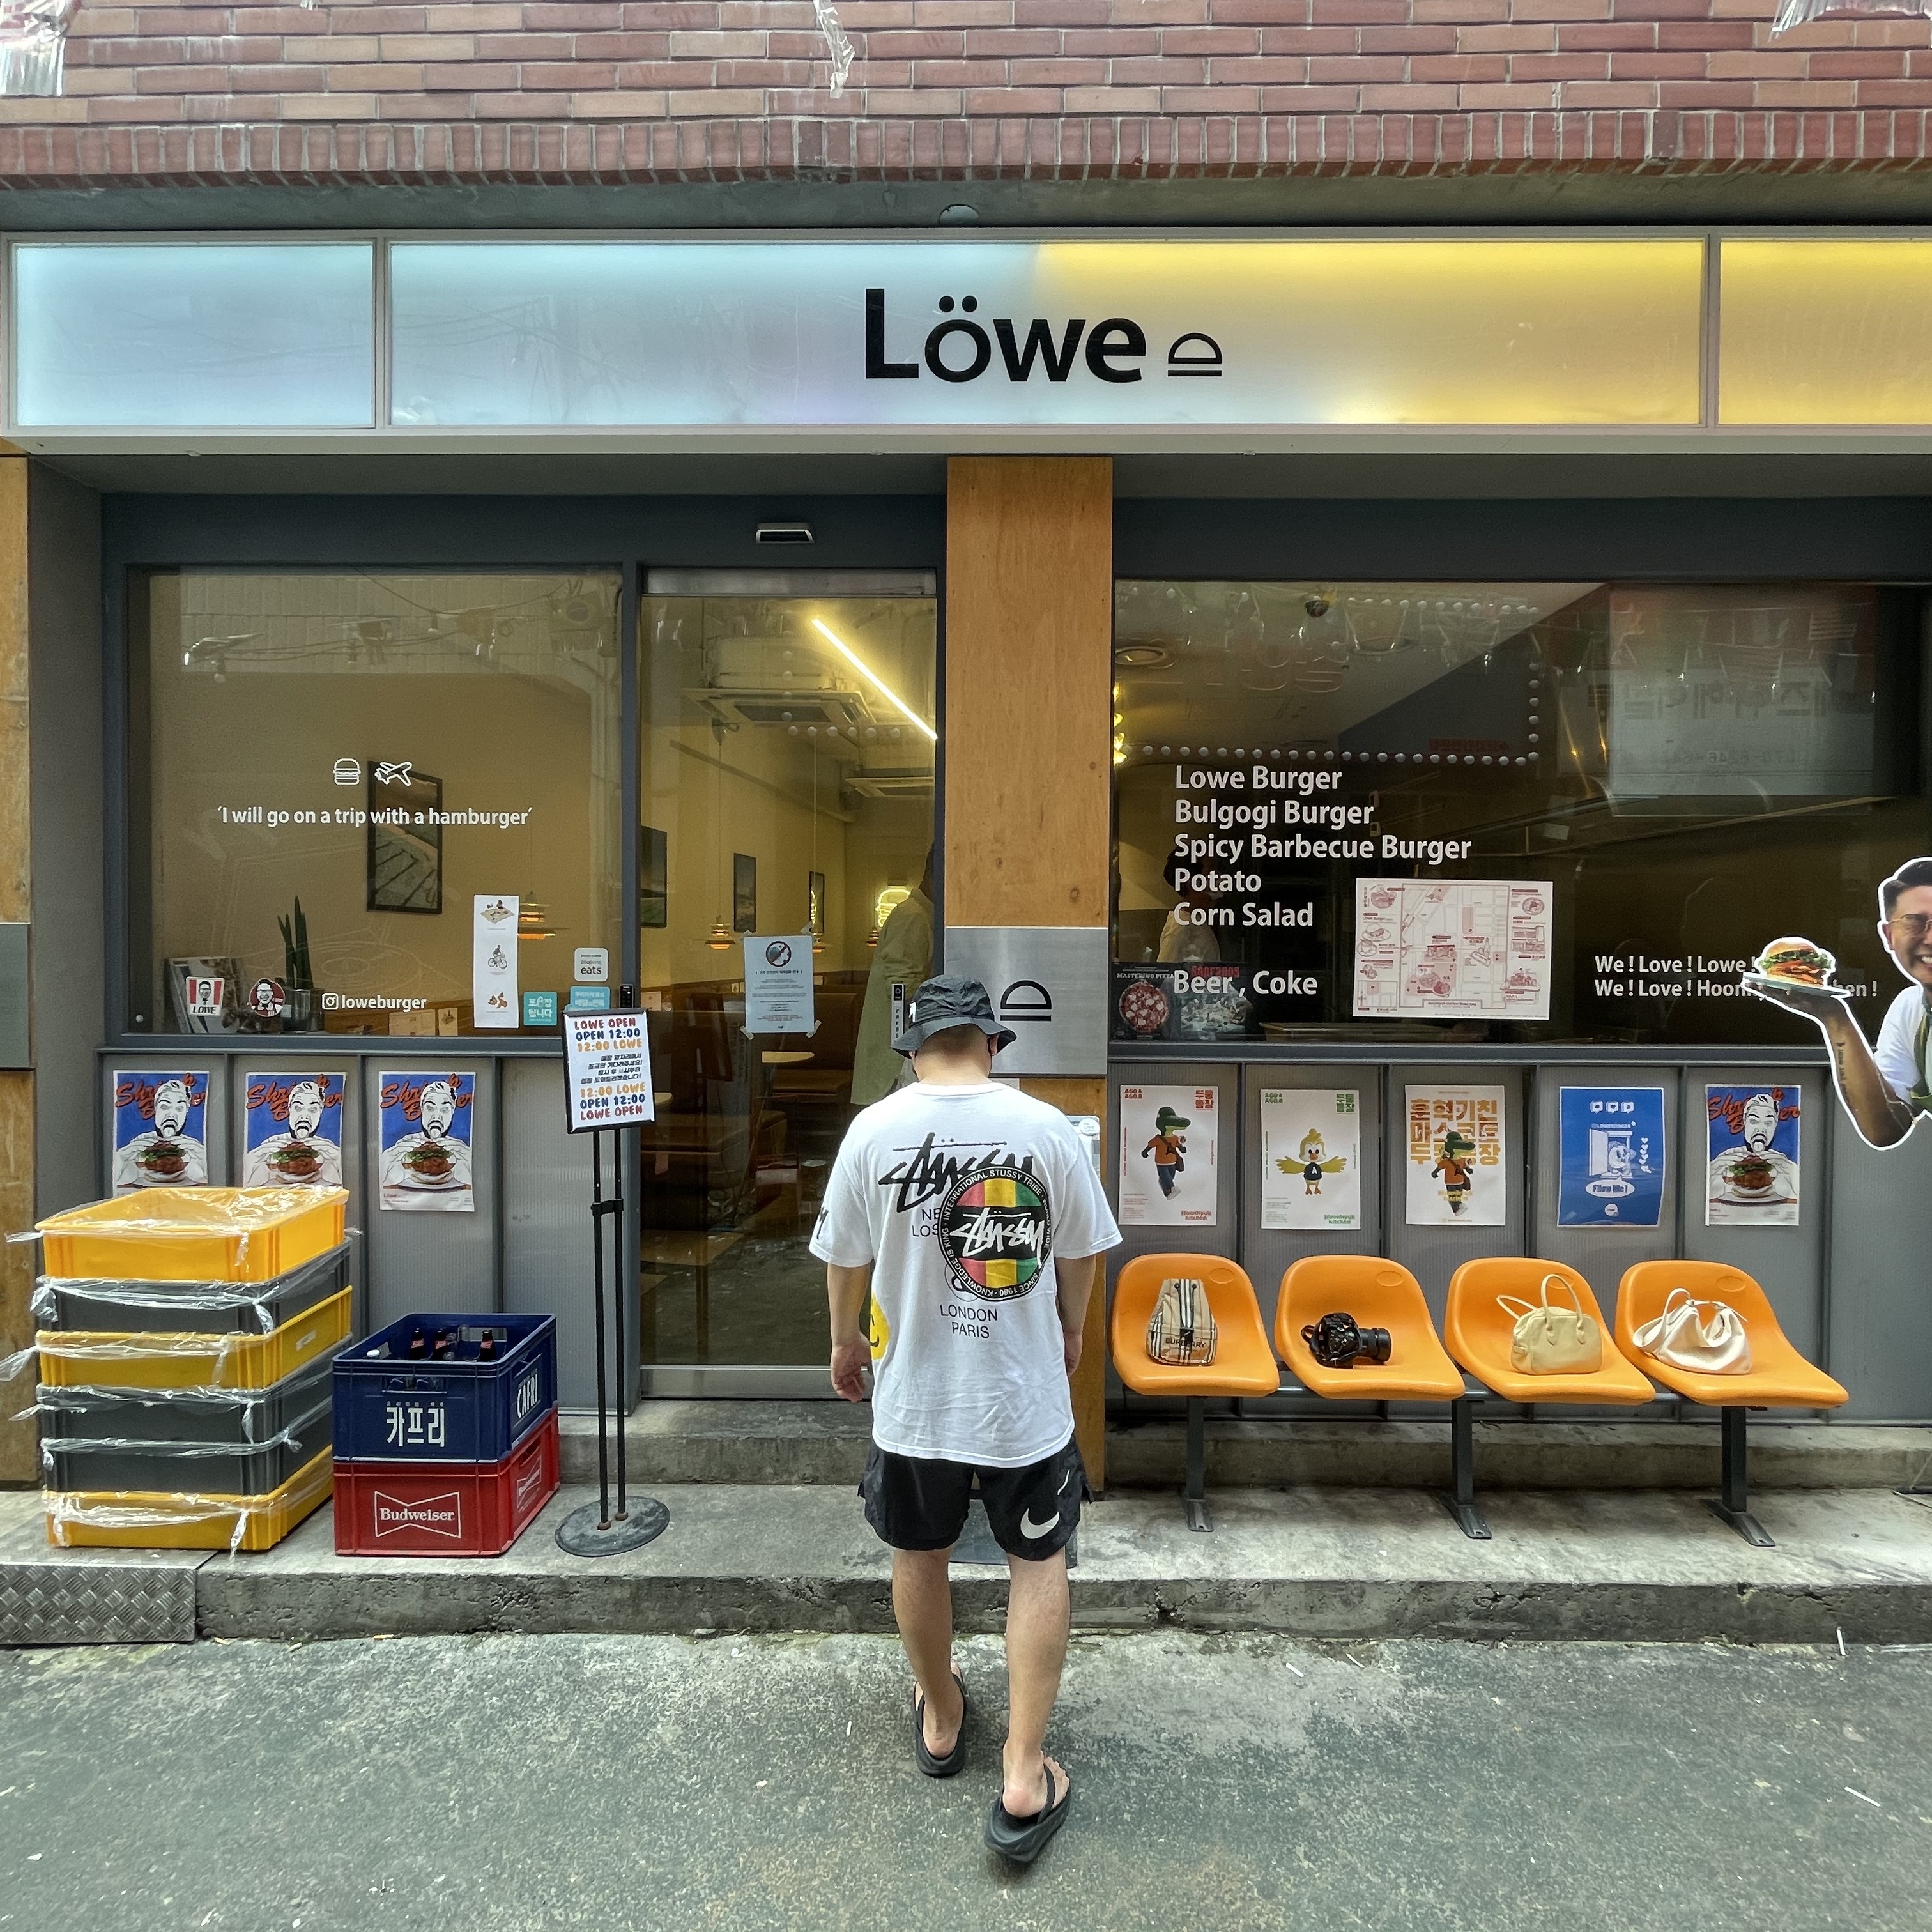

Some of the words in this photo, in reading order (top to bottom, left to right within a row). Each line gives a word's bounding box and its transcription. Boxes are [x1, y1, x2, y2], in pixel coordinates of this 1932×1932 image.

[865, 288, 1146, 383] Löwe
[1175, 765, 1245, 790] Lowe
[1252, 765, 1342, 795] Burger
[231, 806, 263, 823] will
[267, 811, 289, 828] go
[293, 811, 316, 824] on
[320, 811, 330, 824] a
[335, 807, 367, 827] trip
[370, 807, 410, 824] with
[414, 811, 424, 824] a
[1175, 799, 1276, 830] Bulgogi
[1284, 800, 1374, 830] Burger
[1174, 833, 1243, 863] Spicy
[1251, 834, 1374, 858] Barbecue
[1382, 835, 1472, 865] Burger
[1174, 868, 1262, 892] Potato
[1174, 901, 1234, 926] Corn
[1242, 901, 1313, 926] Salad
[581, 966, 602, 974] eats
[1253, 970, 1317, 995] Coke
[192, 1006, 216, 1015] LOWE
[341, 993, 427, 1013] loweburger
[574, 1019, 604, 1031] LOWE
[608, 1017, 636, 1028] OPEN
[576, 1030, 604, 1041] OPEN
[609, 1027, 640, 1039] 12:00
[577, 1041, 610, 1052] 12:00
[613, 1038, 642, 1050] LOWE
[580, 1086, 613, 1098] 12:00
[617, 1082, 646, 1094] LOWE
[580, 1098, 609, 1109] OPEN
[613, 1094, 645, 1105] 12:00
[580, 1109, 610, 1121] LOWE
[615, 1105, 643, 1117] OPEN
[989, 1169, 1022, 1181] STUSSY
[1023, 1176, 1042, 1196] TRIBE
[943, 1172, 988, 1221] INTERNATIONAL
[942, 1228, 951, 1248] KING
[947, 1249, 955, 1257] IS
[951, 1257, 993, 1297] KNOWLEDGE
[1019, 1272, 1038, 1292] SINCE
[999, 1287, 1018, 1298] 1980
[940, 1304, 998, 1321] LONDON
[952, 1322, 990, 1339] PARIS
[517, 1374, 538, 1418] CAFRI
[386, 1407, 445, 1448] 카프리
[379, 1508, 455, 1521] Budweiser
